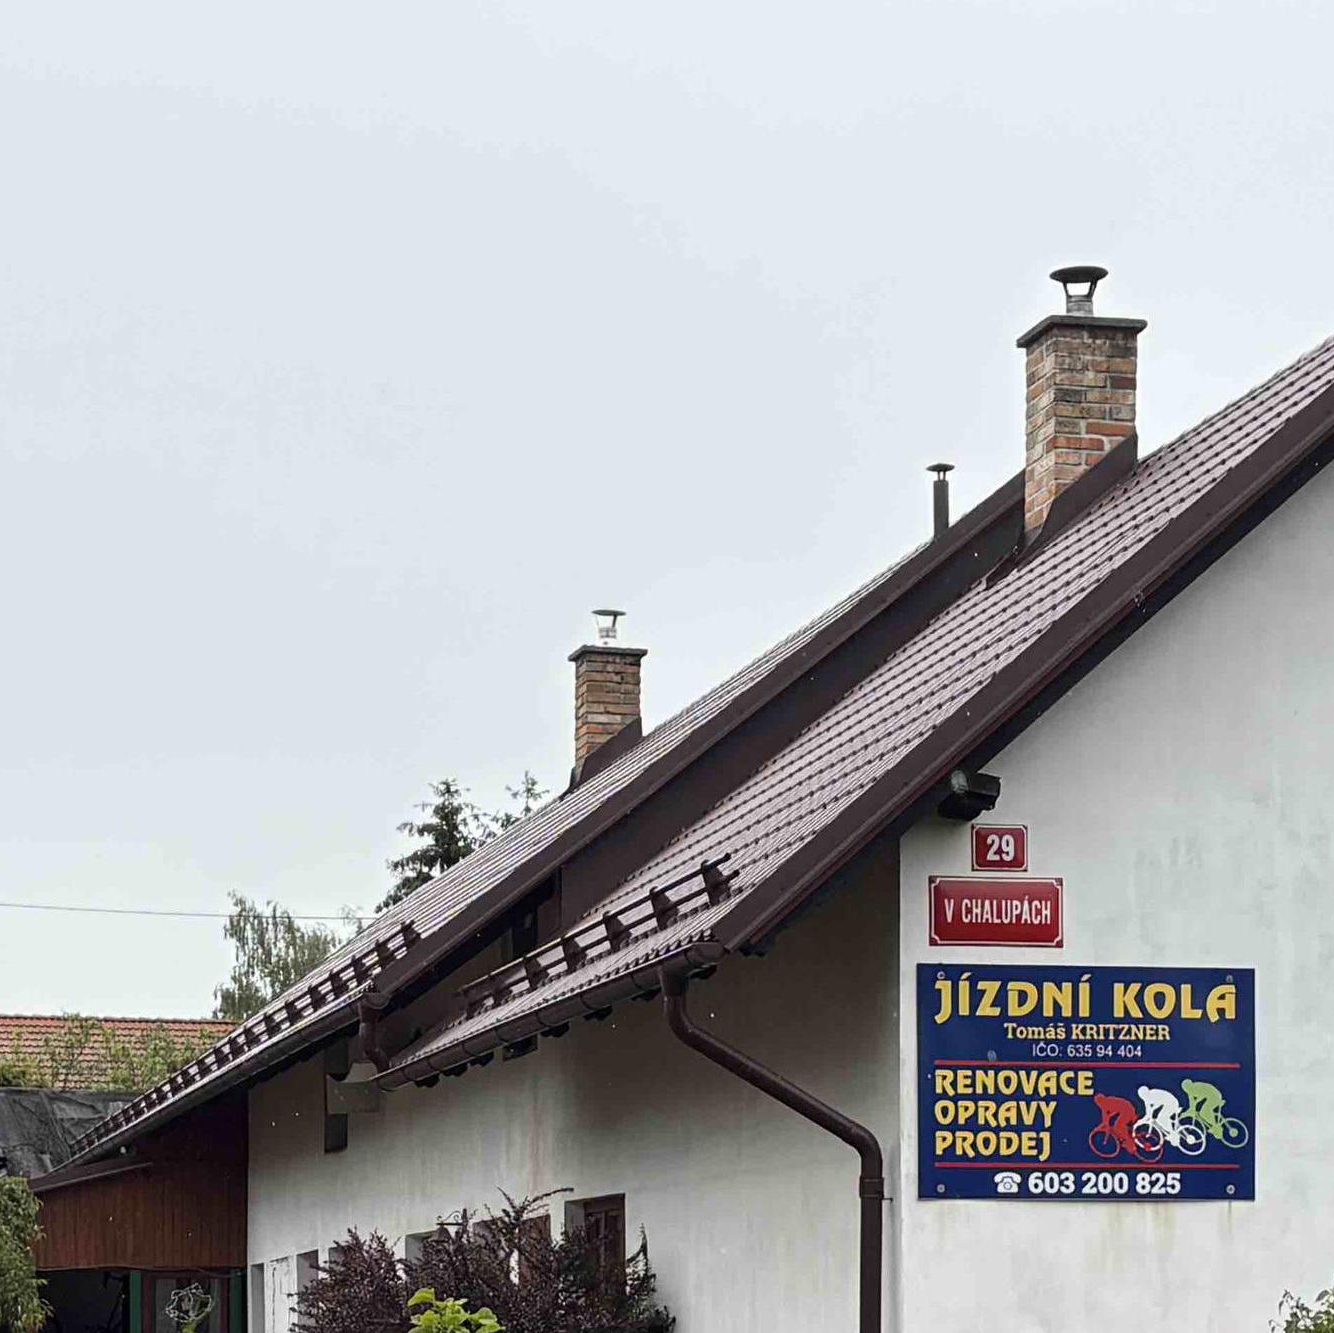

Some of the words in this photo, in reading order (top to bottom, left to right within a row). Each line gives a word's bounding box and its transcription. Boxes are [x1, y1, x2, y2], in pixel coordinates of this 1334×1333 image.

[986, 834, 1015, 862] 29
[944, 898, 954, 923] V
[961, 895, 1051, 925] CHALUPÁCH
[934, 972, 1092, 1024] JÍZDNÍ
[1113, 981, 1237, 1023] KOLA
[1004, 1023, 1066, 1040] Tomáš
[1072, 1024, 1171, 1041] KRITZNER
[1032, 1040, 1063, 1058] IČO:
[1067, 1044, 1093, 1057] 635
[1096, 1045, 1114, 1058] 94
[1117, 1045, 1143, 1058] 404
[935, 1069, 1094, 1097] RENOVACE
[934, 1100, 1057, 1128] OPRAVY
[935, 1131, 1051, 1162] PRODEJ
[1028, 1172, 1076, 1195] 603
[1081, 1172, 1129, 1195] 200
[1135, 1172, 1182, 1195] 825
